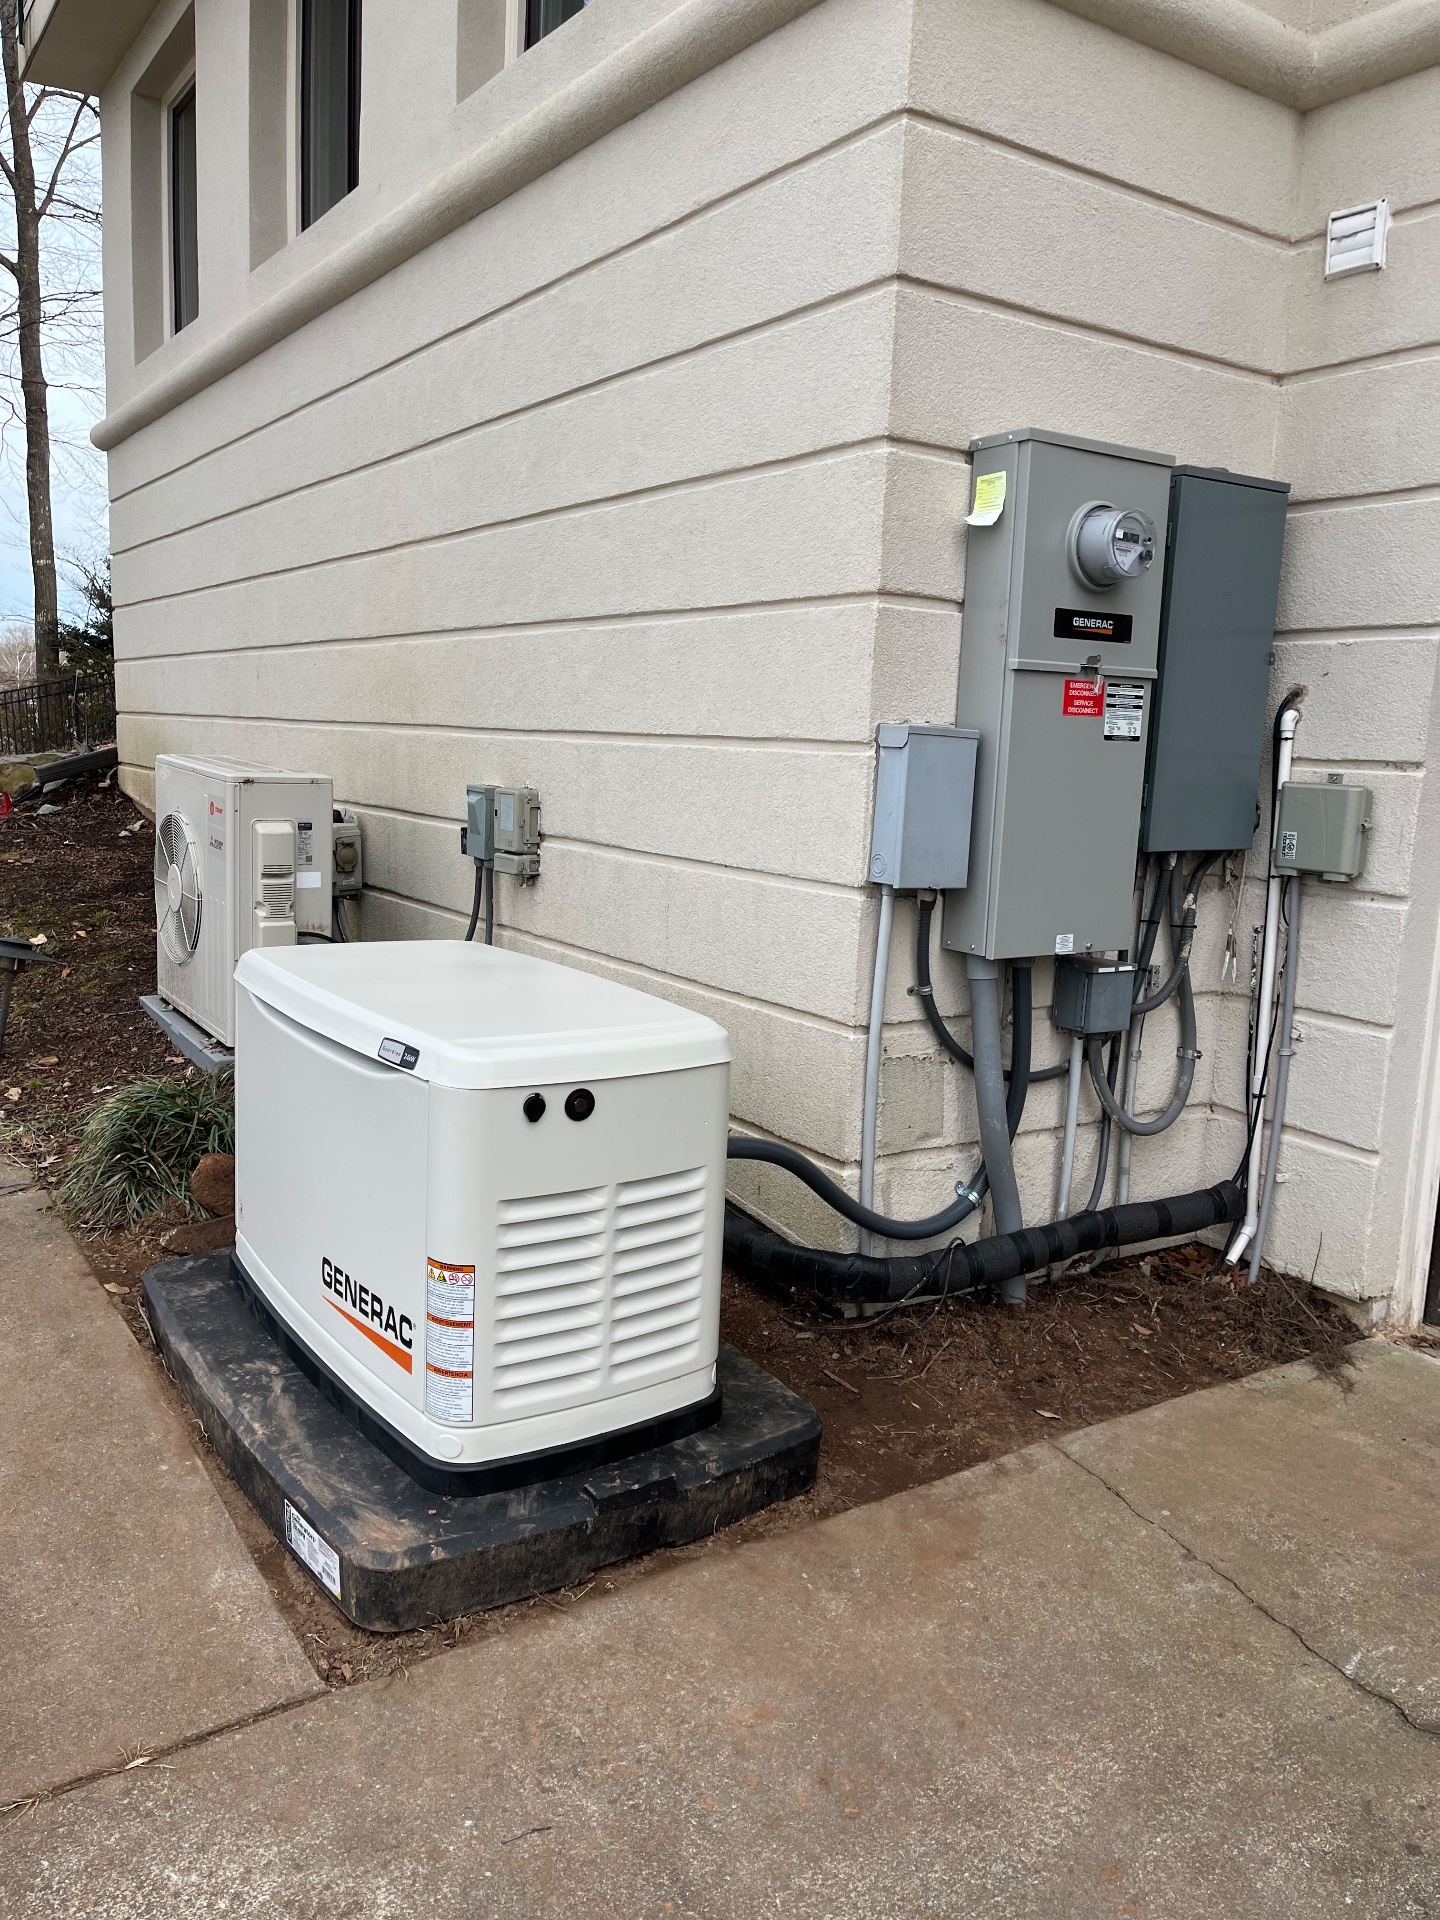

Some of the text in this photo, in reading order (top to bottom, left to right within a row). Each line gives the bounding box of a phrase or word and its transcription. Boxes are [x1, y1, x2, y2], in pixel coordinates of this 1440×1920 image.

[1072, 616, 1114, 629] GENERAC
[1073, 699, 1094, 707] SERVICE
[321, 1256, 413, 1350] GENERAC
